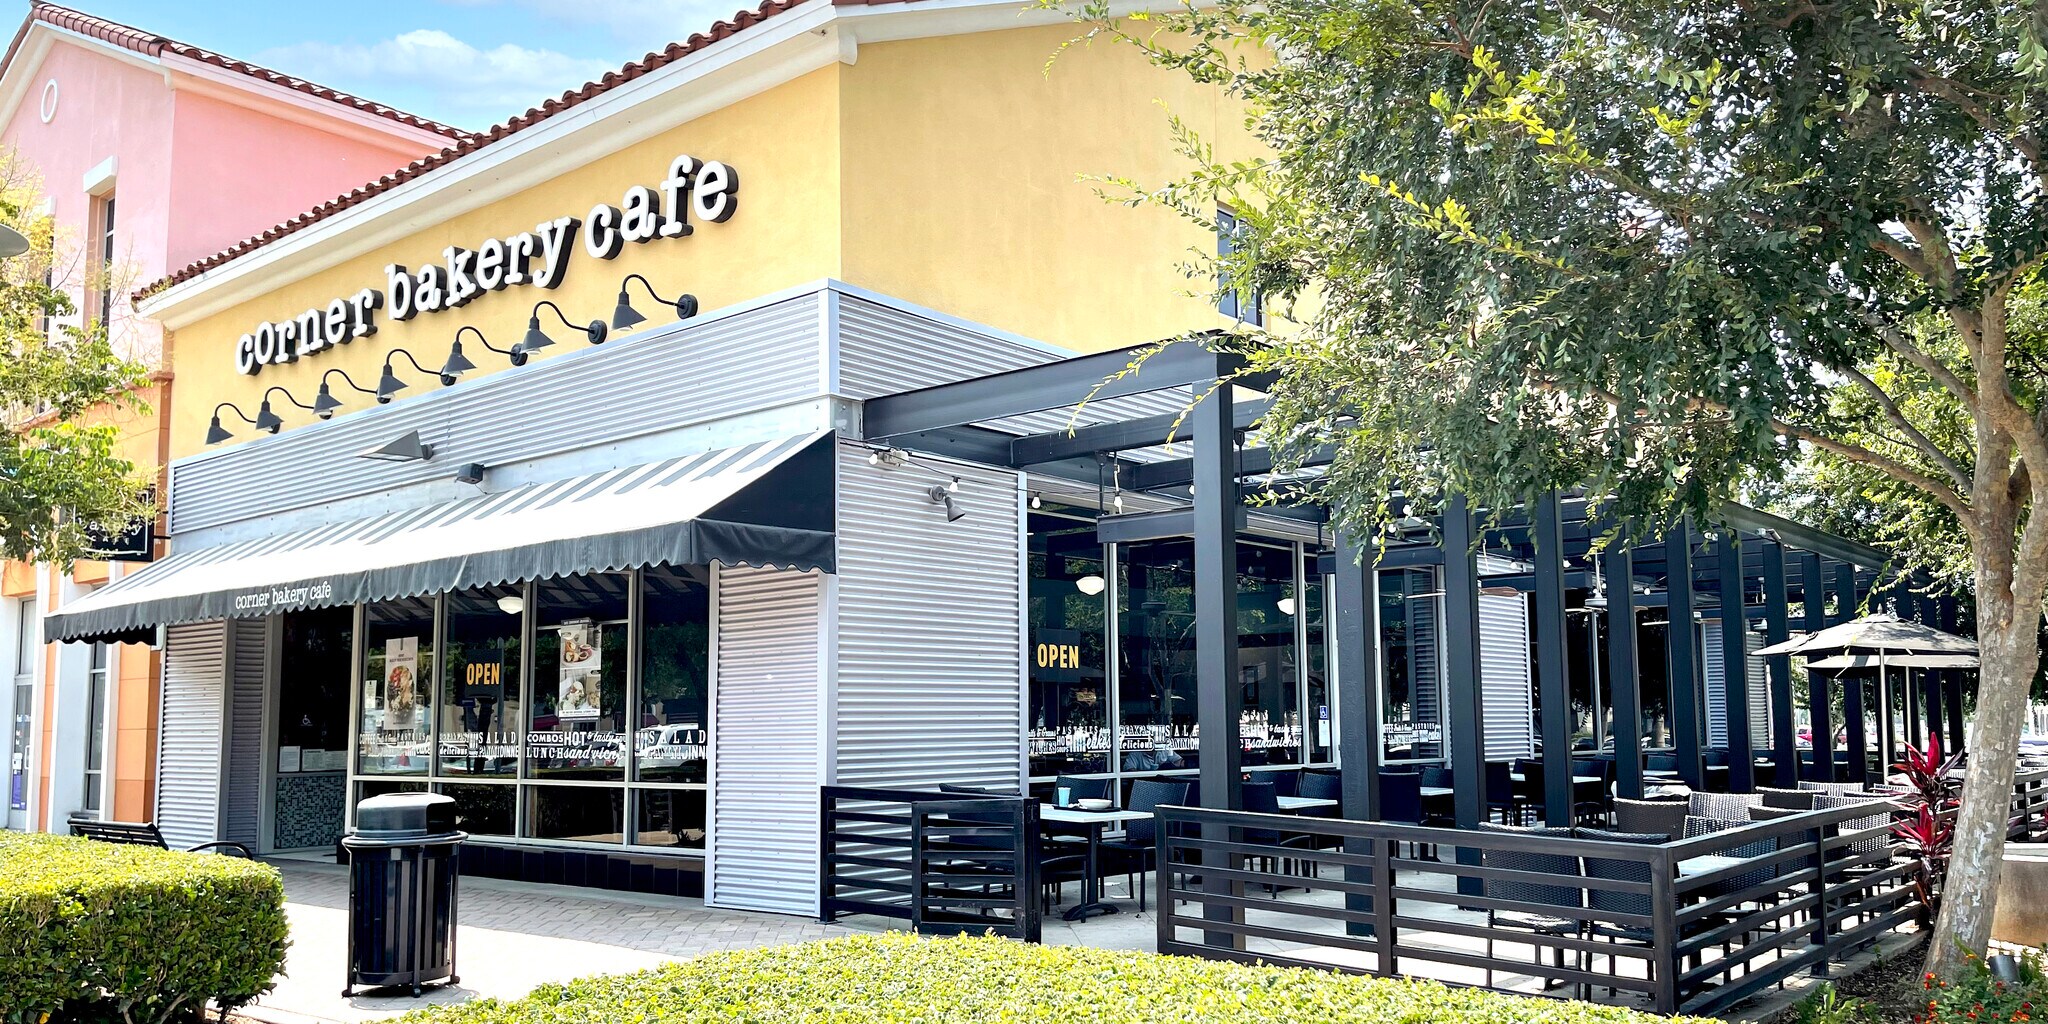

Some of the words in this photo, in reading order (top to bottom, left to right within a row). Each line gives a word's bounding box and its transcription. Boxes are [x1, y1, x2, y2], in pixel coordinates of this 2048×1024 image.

[235, 288, 383, 376] corner
[386, 215, 581, 321] bakery
[584, 154, 739, 261] cafe
[235, 592, 270, 609] corner
[272, 586, 309, 606] bakery
[310, 580, 332, 600] cafe
[1037, 644, 1079, 669] OPEN
[466, 662, 500, 685] OPEN
[527, 733, 563, 743] COMBOS
[564, 731, 586, 747] HOT
[593, 731, 614, 747] tasty
[439, 743, 469, 756] delicious
[526, 746, 564, 759] LUNCH
